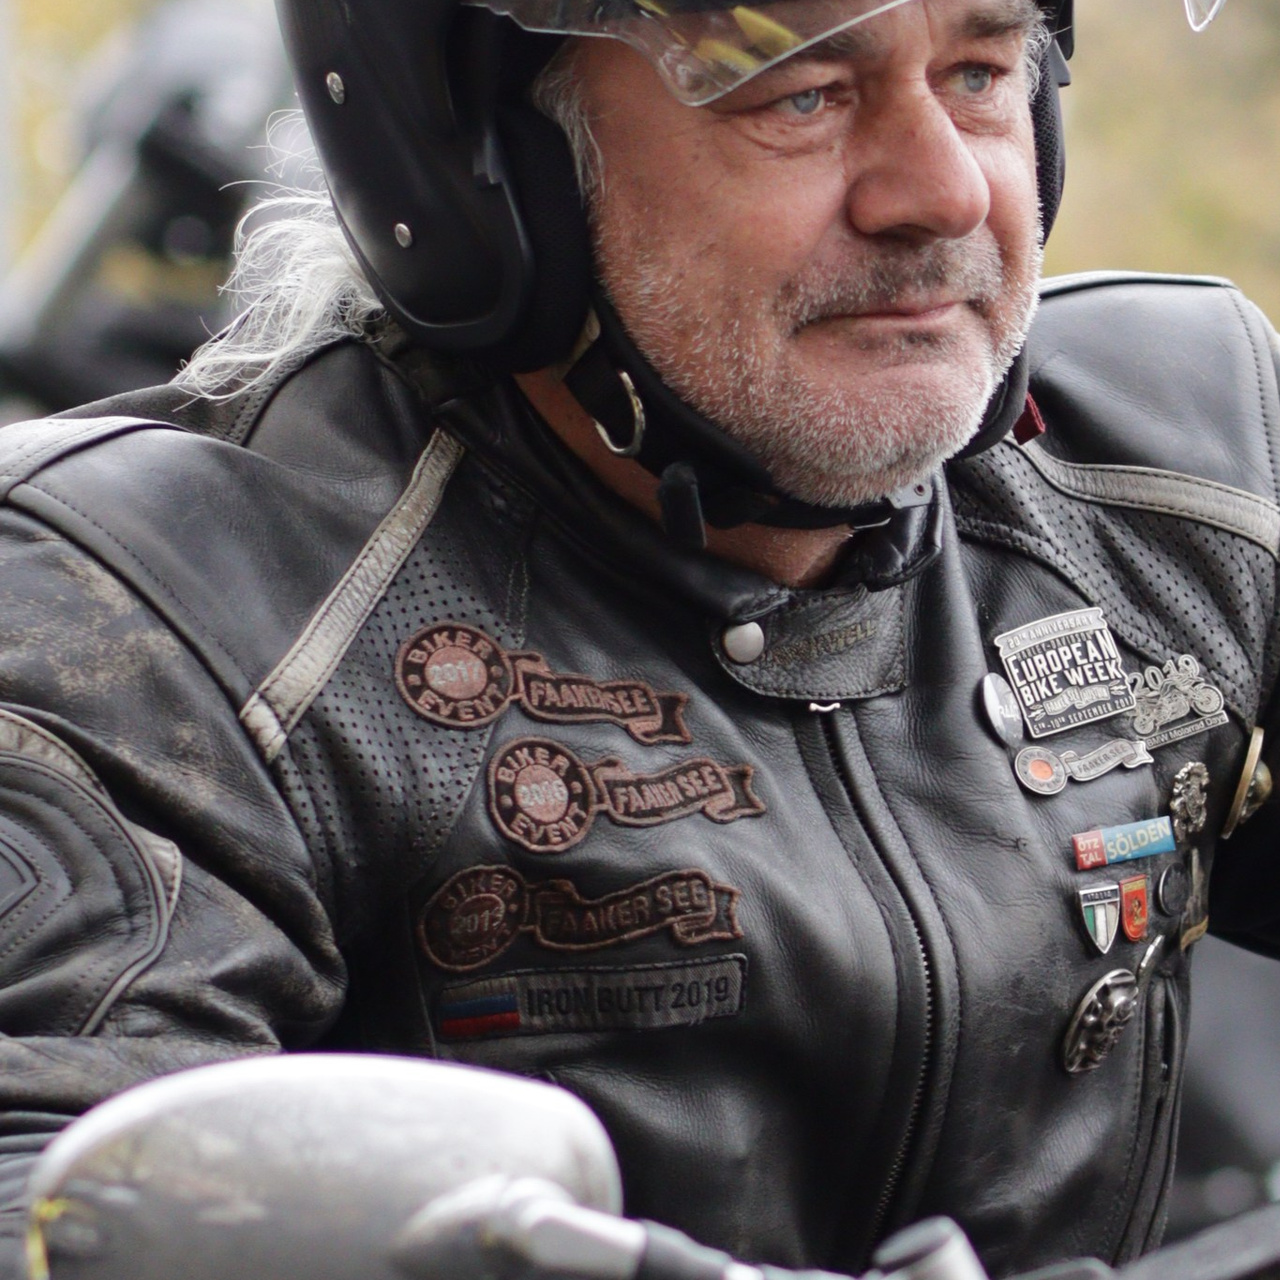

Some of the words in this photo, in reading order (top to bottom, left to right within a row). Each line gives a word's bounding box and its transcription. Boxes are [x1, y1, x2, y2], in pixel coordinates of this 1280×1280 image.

[1029, 614, 1094, 640] ANNIVERSARY
[406, 629, 495, 665] BIKER
[1006, 629, 1118, 688] EUROPEAN
[1019, 673, 1063, 707] BIKE
[1063, 659, 1123, 687] WEEK
[1128, 654, 1201, 693] 2019
[416, 682, 506, 721] EVENT
[609, 687, 652, 715] SEE
[1067, 701, 1113, 724] SEPTEMBER
[1146, 732, 1169, 747] BMW
[1168, 719, 1206, 740] Motorrad
[497, 746, 570, 784] BIKER
[677, 765, 721, 802] SEE
[509, 801, 588, 844] EVENT
[1106, 819, 1171, 860] SÖLDEN
[1078, 837, 1099, 852] ÖTZ
[1080, 851, 1102, 864] TAL
[438, 872, 518, 909] BIKER
[547, 894, 649, 935] FAAKER
[655, 879, 708, 914] SEE
[526, 986, 589, 1017] IRON
[596, 985, 664, 1015] BUTT
[671, 974, 730, 1010] 2019
